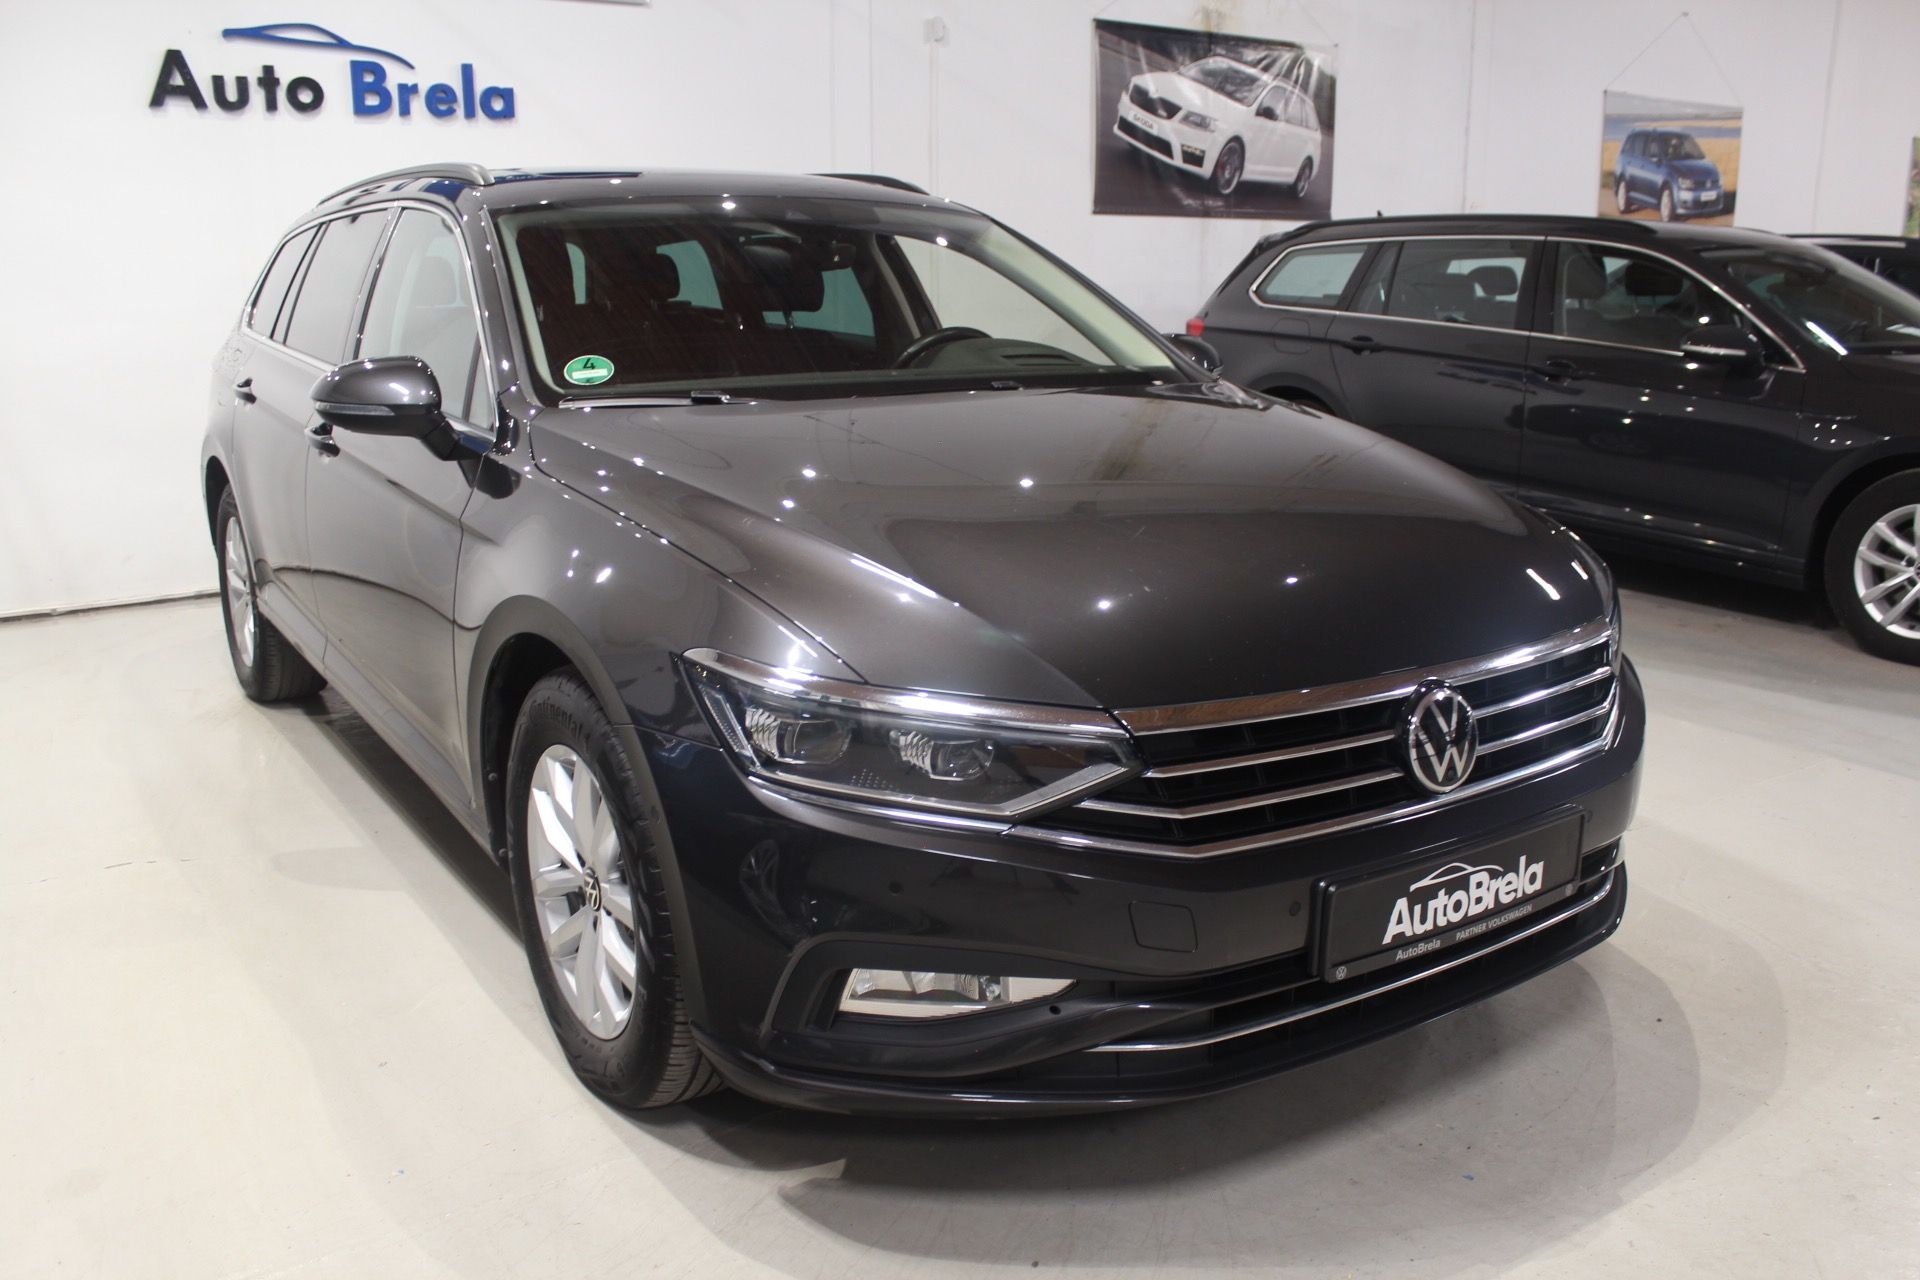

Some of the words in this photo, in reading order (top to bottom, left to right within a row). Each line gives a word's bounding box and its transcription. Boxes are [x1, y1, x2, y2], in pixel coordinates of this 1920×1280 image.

[149, 49, 324, 112] Auto
[350, 60, 515, 119] Brela
[583, 358, 596, 369] 4
[1382, 855, 1544, 945] AutoBrela
[1456, 922, 1487, 941] PARTNER
[1488, 904, 1533, 929] VOLKSWAGEN
[1396, 938, 1441, 961] AutoBrela
